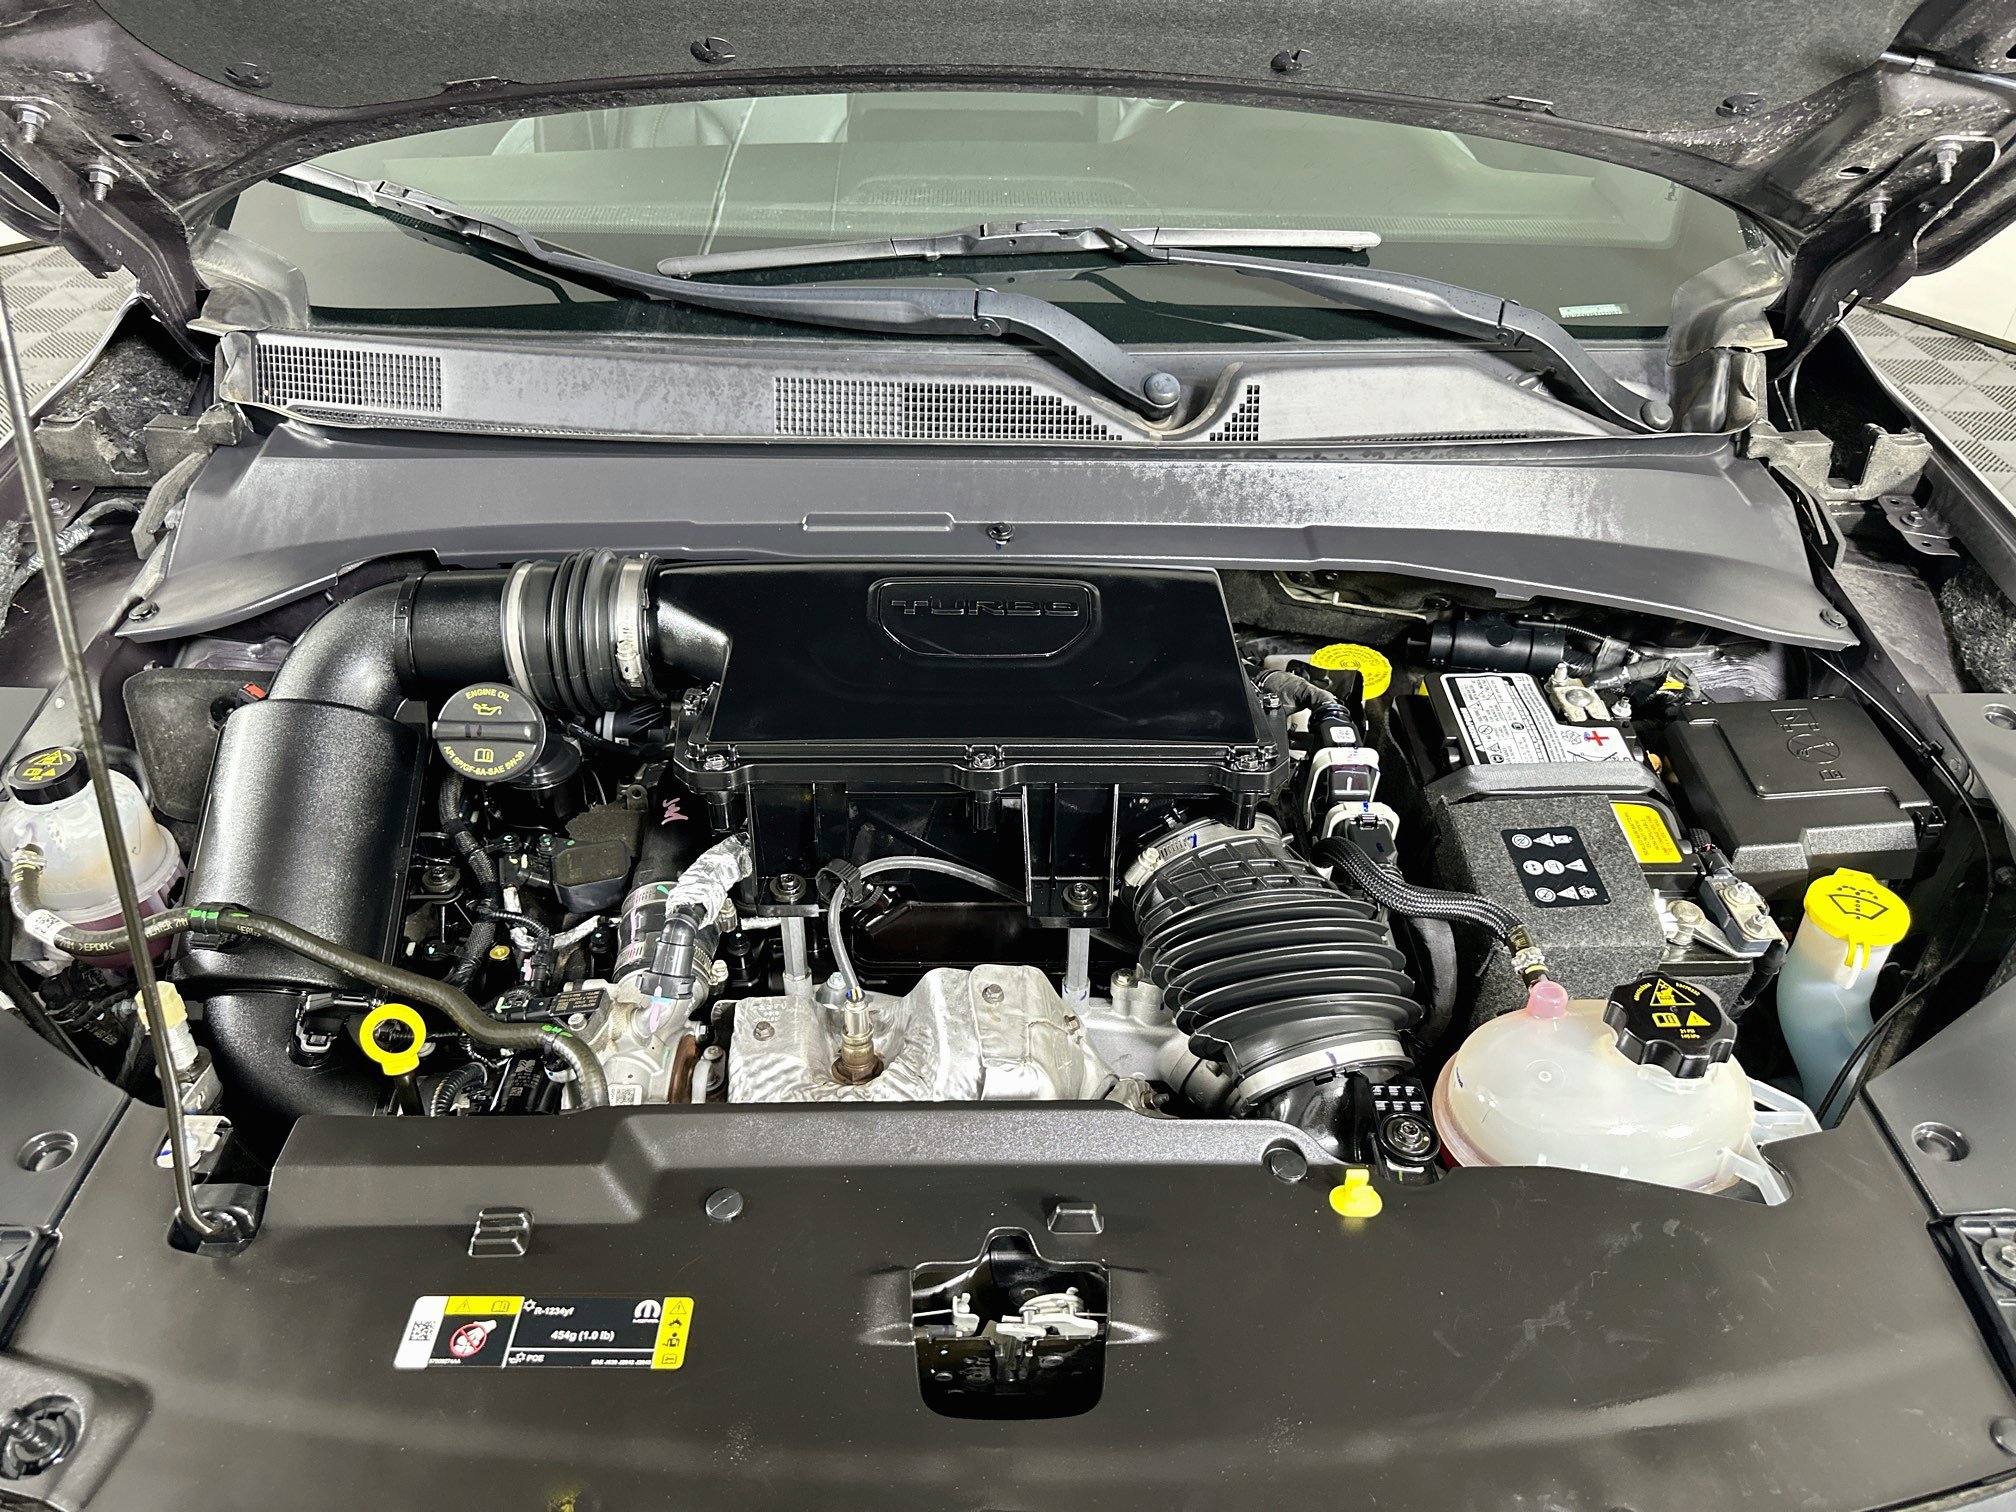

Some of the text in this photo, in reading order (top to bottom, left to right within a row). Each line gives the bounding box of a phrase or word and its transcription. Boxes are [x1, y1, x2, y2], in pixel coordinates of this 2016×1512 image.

[890, 600, 1080, 617] TURBO
[465, 688, 510, 702] ENGINE OIL
[444, 746, 456, 758] API
[504, 750, 526, 770] 5W-30
[144, 920, 172, 938] HEATER
[533, 1306, 575, 1318] R-1234yf
[550, 1330, 616, 1342] 454g (1.0 lb)
[526, 1354, 546, 1363] POE
